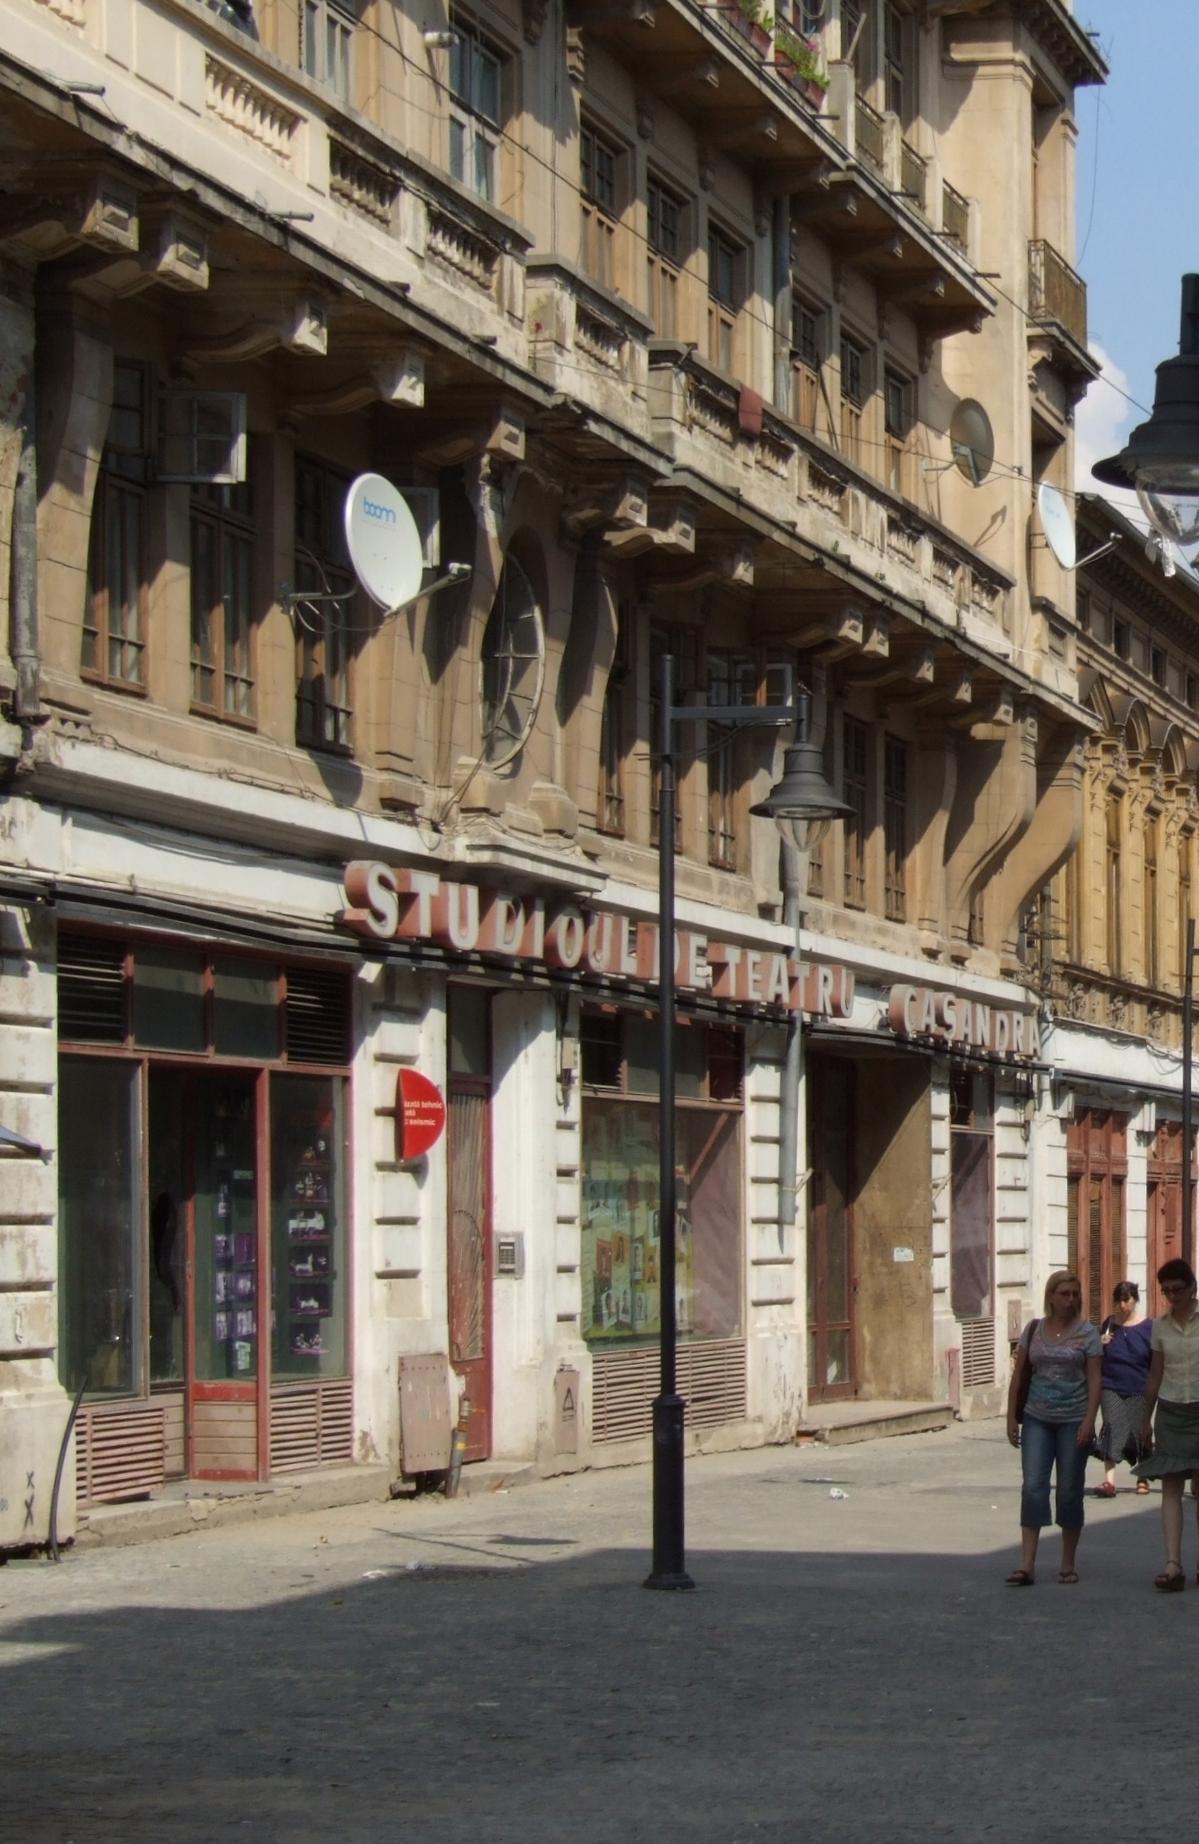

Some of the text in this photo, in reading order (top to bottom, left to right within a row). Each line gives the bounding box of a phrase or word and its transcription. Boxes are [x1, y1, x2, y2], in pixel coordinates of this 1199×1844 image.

[363, 497, 396, 523] boom
[346, 861, 637, 976] STUDIOUL
[713, 943, 855, 1018] TEATRU
[893, 984, 1041, 1057] CASANDRA
